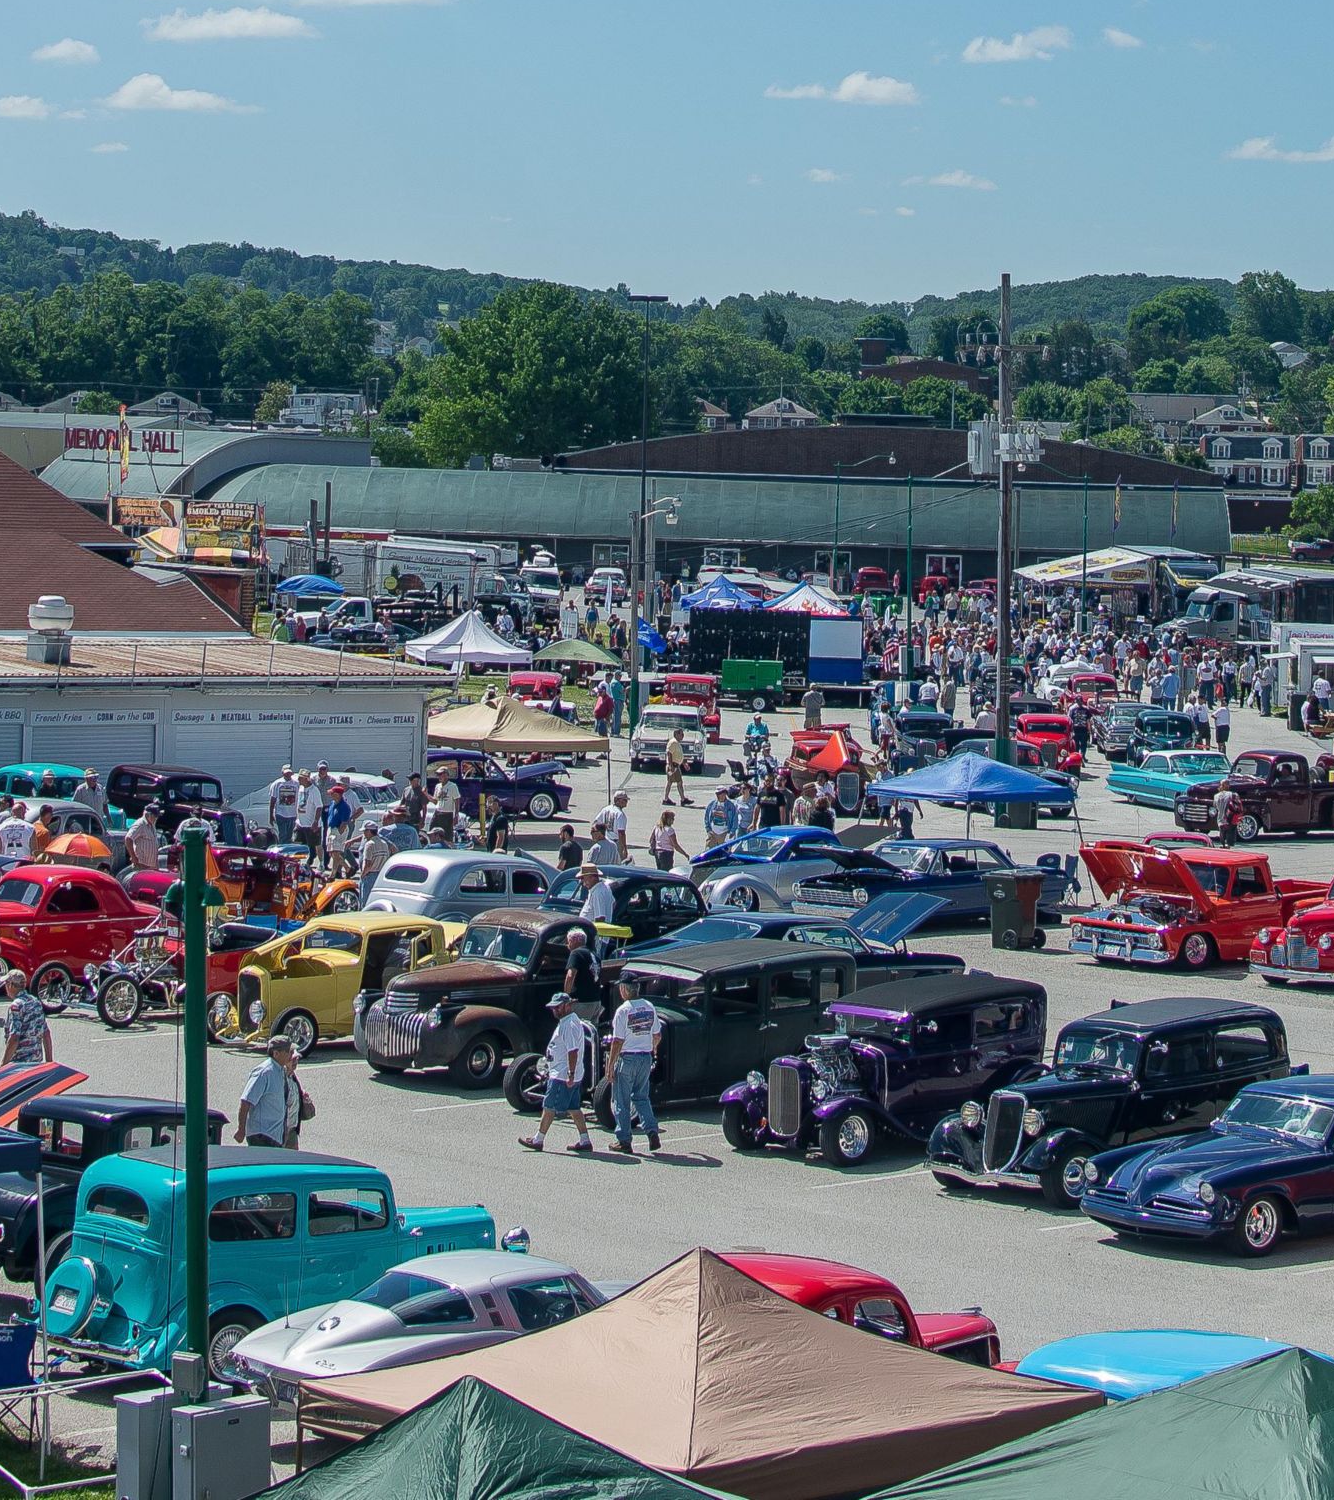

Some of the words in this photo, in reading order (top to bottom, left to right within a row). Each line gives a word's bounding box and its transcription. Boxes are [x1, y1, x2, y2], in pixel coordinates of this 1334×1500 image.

[66, 428, 138, 451] MEMORIL
[142, 430, 179, 453] HALL
[4, 711, 21, 720] BBQ
[35, 713, 62, 722] French
[63, 713, 83, 722] Fries
[97, 713, 114, 721] CORN
[127, 712, 140, 720] the
[142, 712, 155, 720] COB
[174, 712, 205, 722] Sausage
[221, 712, 252, 722] MEATBALL
[258, 712, 294, 722] Sandwiches
[302, 715, 327, 724] Italian
[329, 715, 353, 724] STEAKS
[367, 715, 391, 724] Cheese
[393, 714, 415, 723] STEAKS
